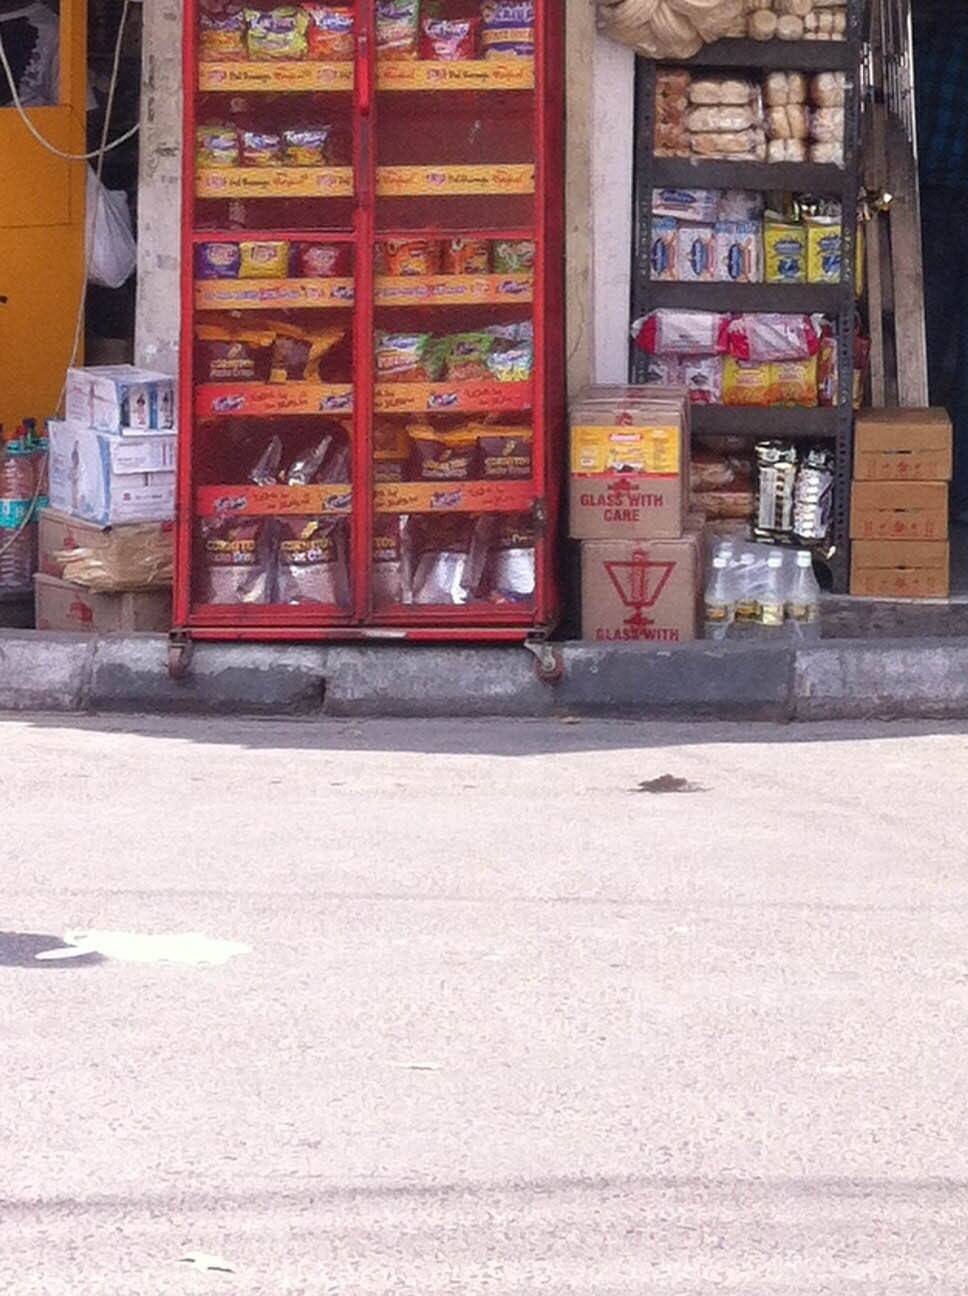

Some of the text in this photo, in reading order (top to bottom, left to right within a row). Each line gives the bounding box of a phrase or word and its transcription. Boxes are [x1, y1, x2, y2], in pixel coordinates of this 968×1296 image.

[580, 493, 664, 507] GLASS WITH
[603, 508, 640, 523] CARE
